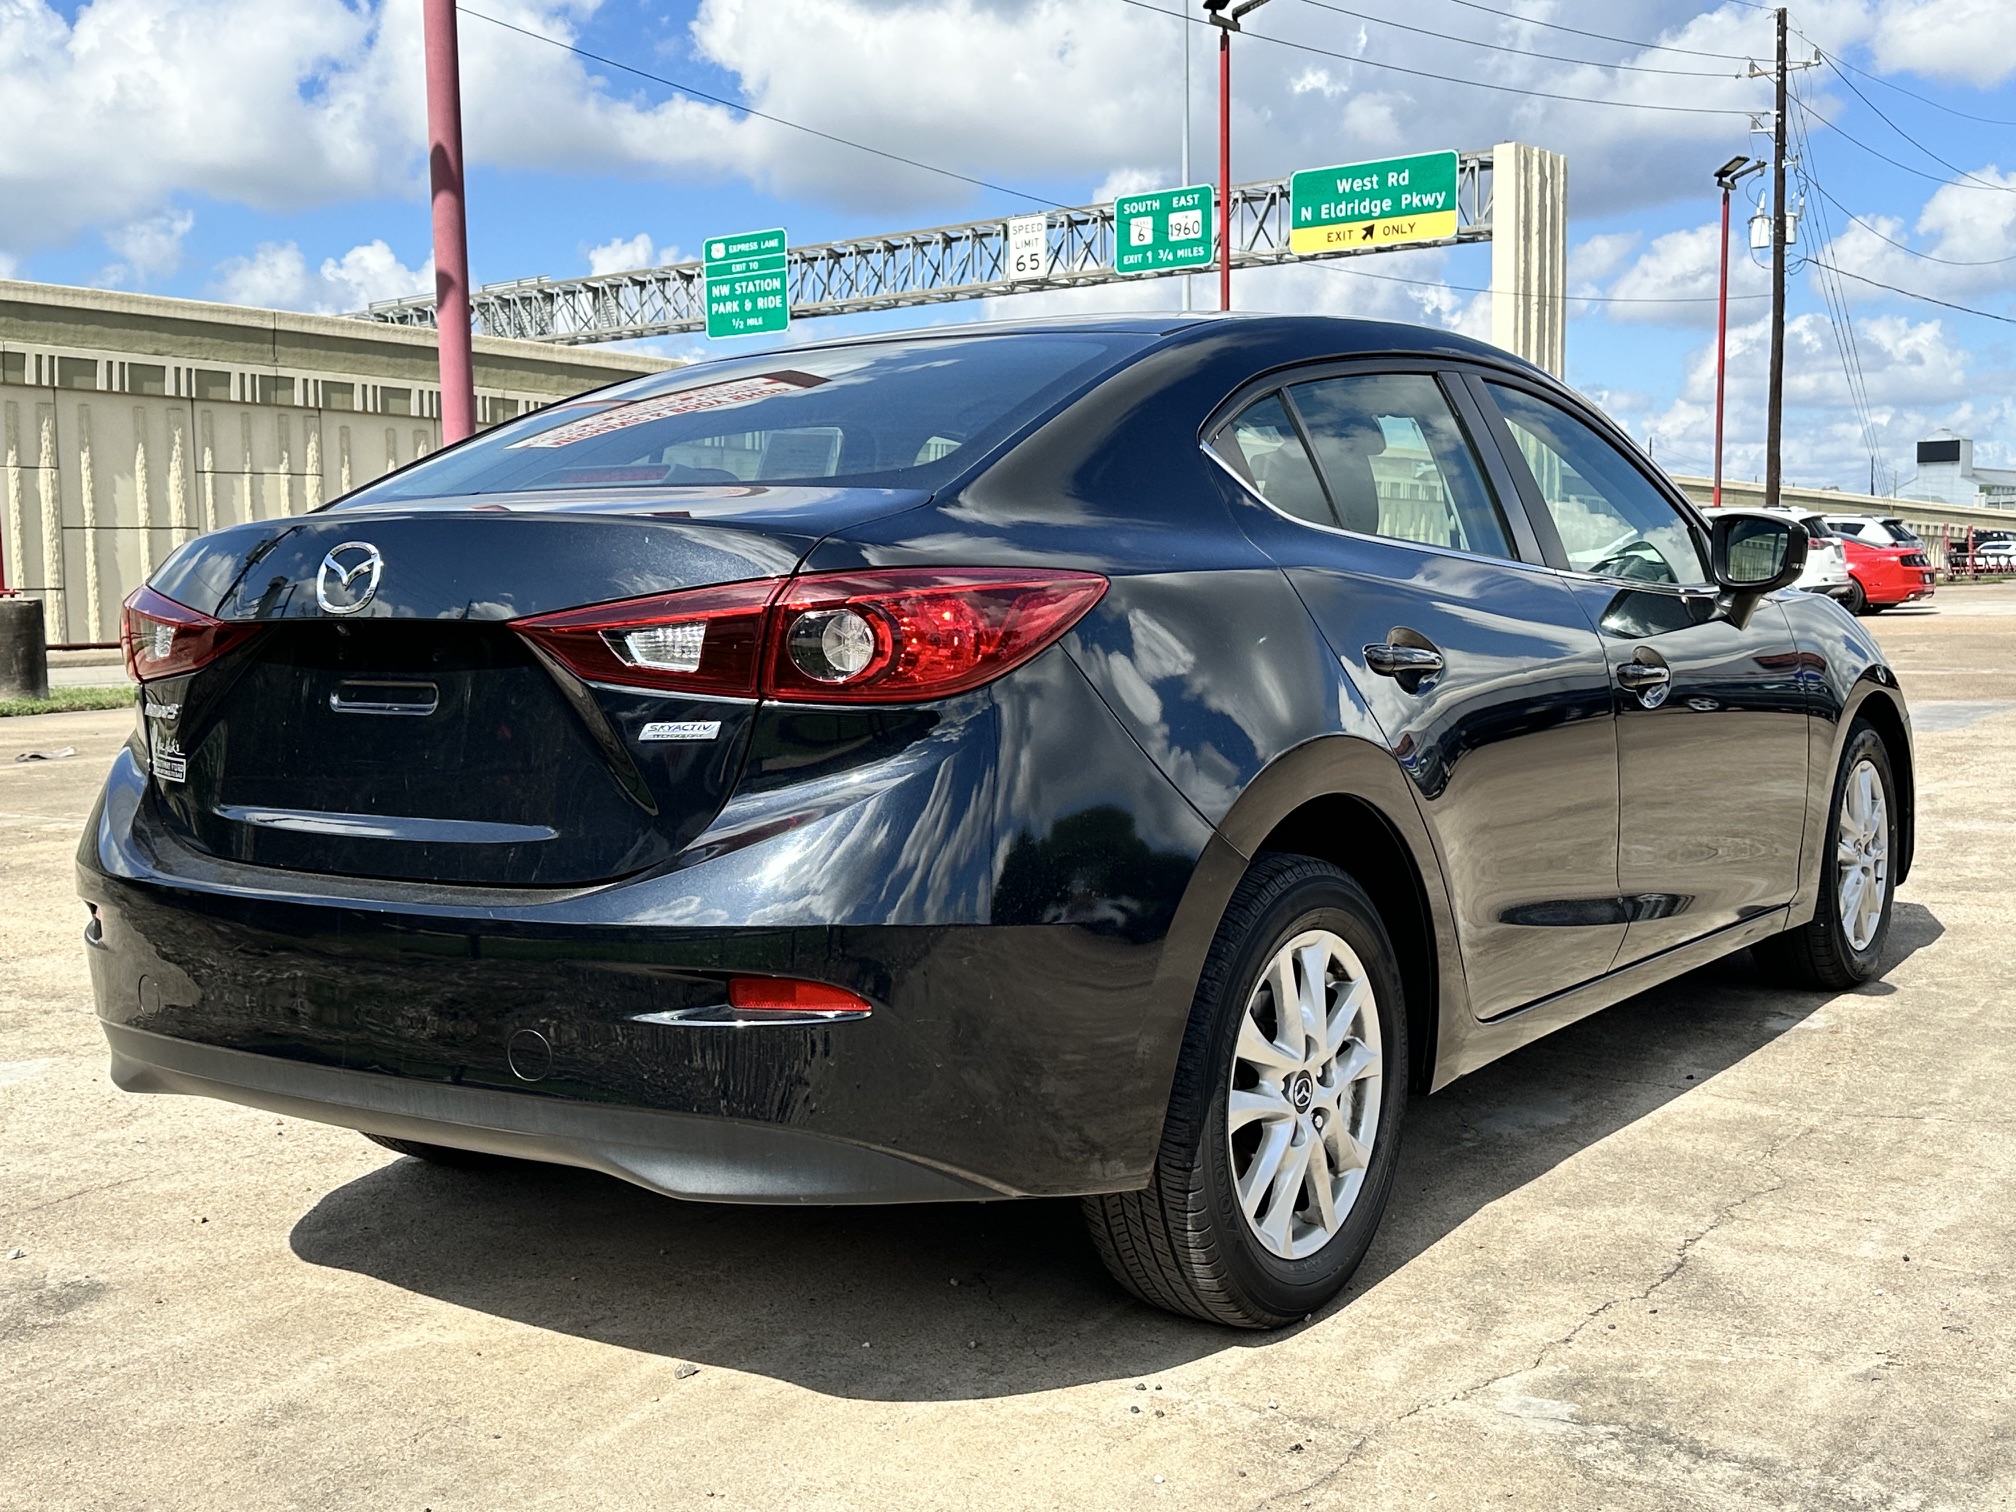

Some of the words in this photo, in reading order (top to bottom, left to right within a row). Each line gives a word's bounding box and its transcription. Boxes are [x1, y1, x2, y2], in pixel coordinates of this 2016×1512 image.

[1336, 174, 1379, 194] West
[1387, 169, 1409, 187] Rd
[1123, 199, 1160, 214] SOUTH
[1172, 194, 1200, 208] EAST
[1300, 206, 1312, 222] N
[1321, 197, 1392, 219] Eldridge
[1401, 191, 1446, 209] Pkwy
[1012, 223, 1043, 235] SPEED
[1137, 228, 1145, 242] 6
[1170, 220, 1200, 237] 1960
[1327, 230, 1353, 243] EXIT
[1383, 222, 1416, 236] ONLY
[728, 241, 758, 253] EXPRESS
[761, 239, 779, 249] LANE
[1015, 238, 1039, 250] LIMIT
[1016, 253, 1040, 272] 65
[1123, 254, 1142, 265] EXIT
[1146, 251, 1153, 263] 1
[1157, 248, 1173, 262] 3/4
[1176, 246, 1205, 259] MILES
[732, 262, 746, 273] EXIT
[749, 261, 758, 270] TO
[711, 284, 730, 297] NW
[735, 278, 781, 294] STATION
[711, 300, 739, 315] PARK
[744, 299, 752, 311] &
[757, 295, 782, 309] RIDE
[732, 318, 744, 329] 1/2
[746, 317, 763, 326] MILE
